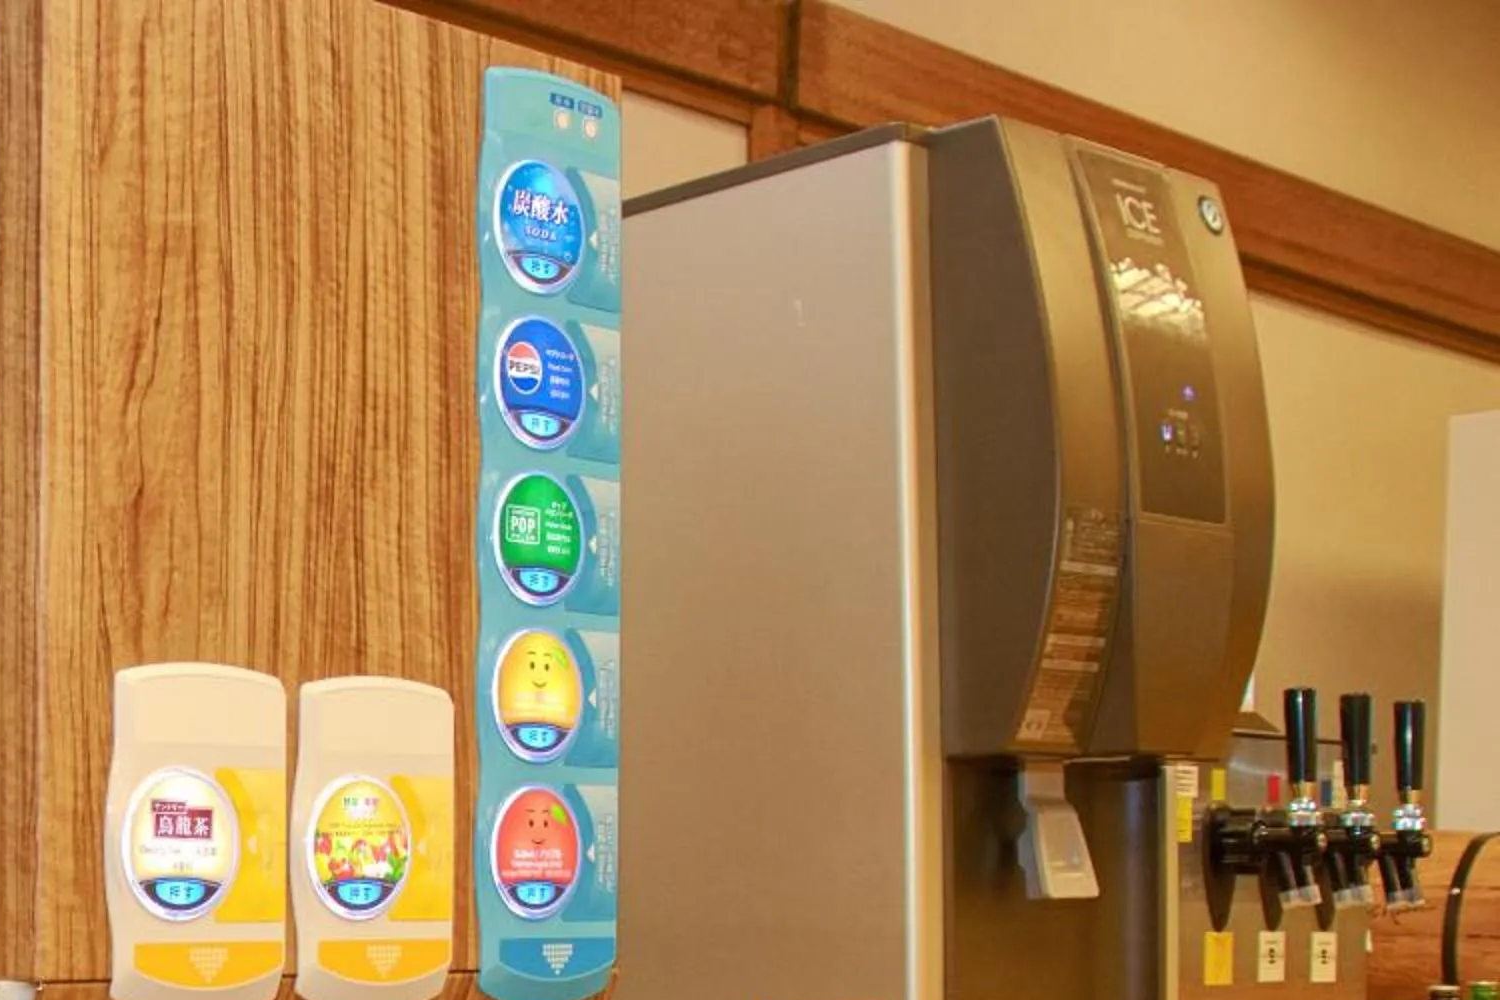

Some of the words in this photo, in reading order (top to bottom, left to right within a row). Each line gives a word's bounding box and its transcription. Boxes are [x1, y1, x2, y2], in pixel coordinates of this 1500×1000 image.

[512, 189, 570, 226] 炭酸水
[1114, 192, 1162, 234] ICE
[510, 515, 536, 533] POP
[157, 814, 210, 837] 烏龍茶
